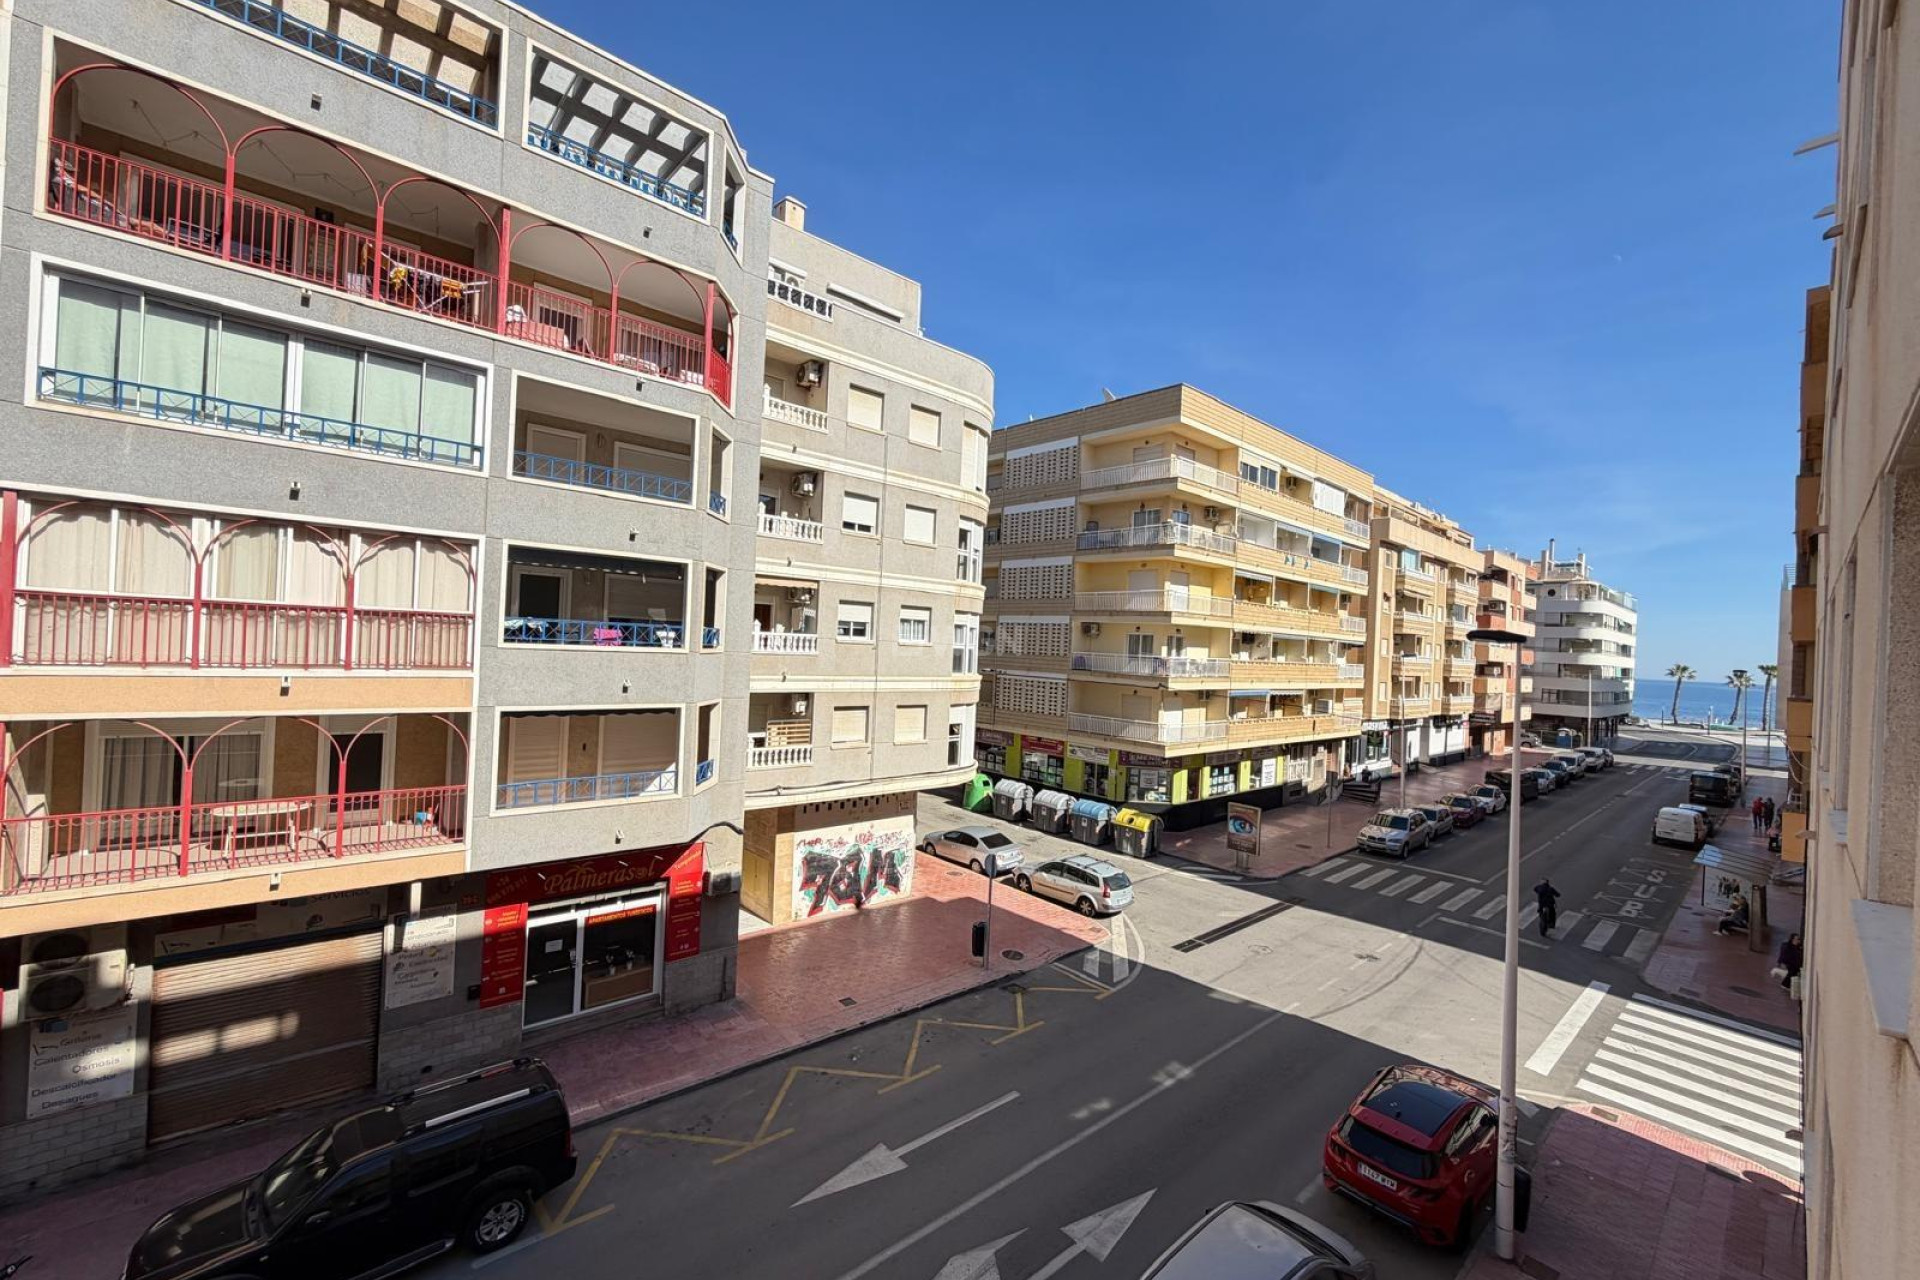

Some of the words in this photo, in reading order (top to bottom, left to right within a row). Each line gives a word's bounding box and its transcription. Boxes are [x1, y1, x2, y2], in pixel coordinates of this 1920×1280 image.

[544, 858, 658, 894] Palmerasol
[1618, 869, 1668, 918] BUS
[34, 1046, 109, 1067] Calentadores
[72, 1057, 120, 1073] Osmosis
[31, 1074, 117, 1098] Descalcificador
